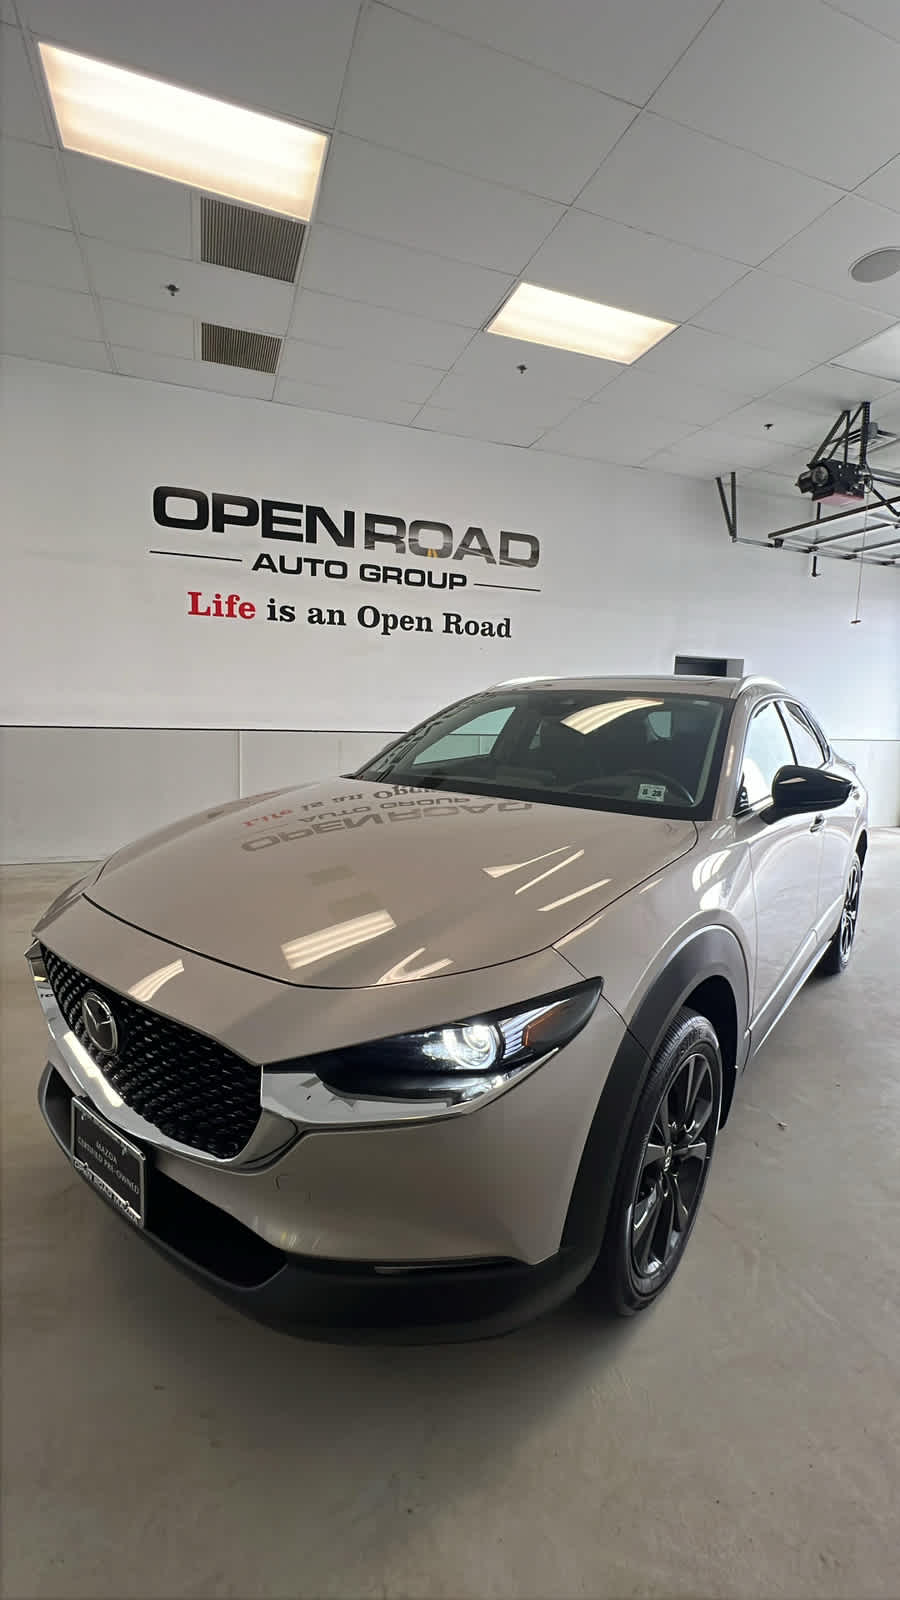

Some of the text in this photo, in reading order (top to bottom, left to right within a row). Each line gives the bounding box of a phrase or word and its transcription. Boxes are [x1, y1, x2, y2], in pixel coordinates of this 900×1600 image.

[251, 553, 467, 590] AUTO GROUP
[187, 591, 512, 638] Life is an Open Road
[95, 1141, 118, 1164] MAZDA
